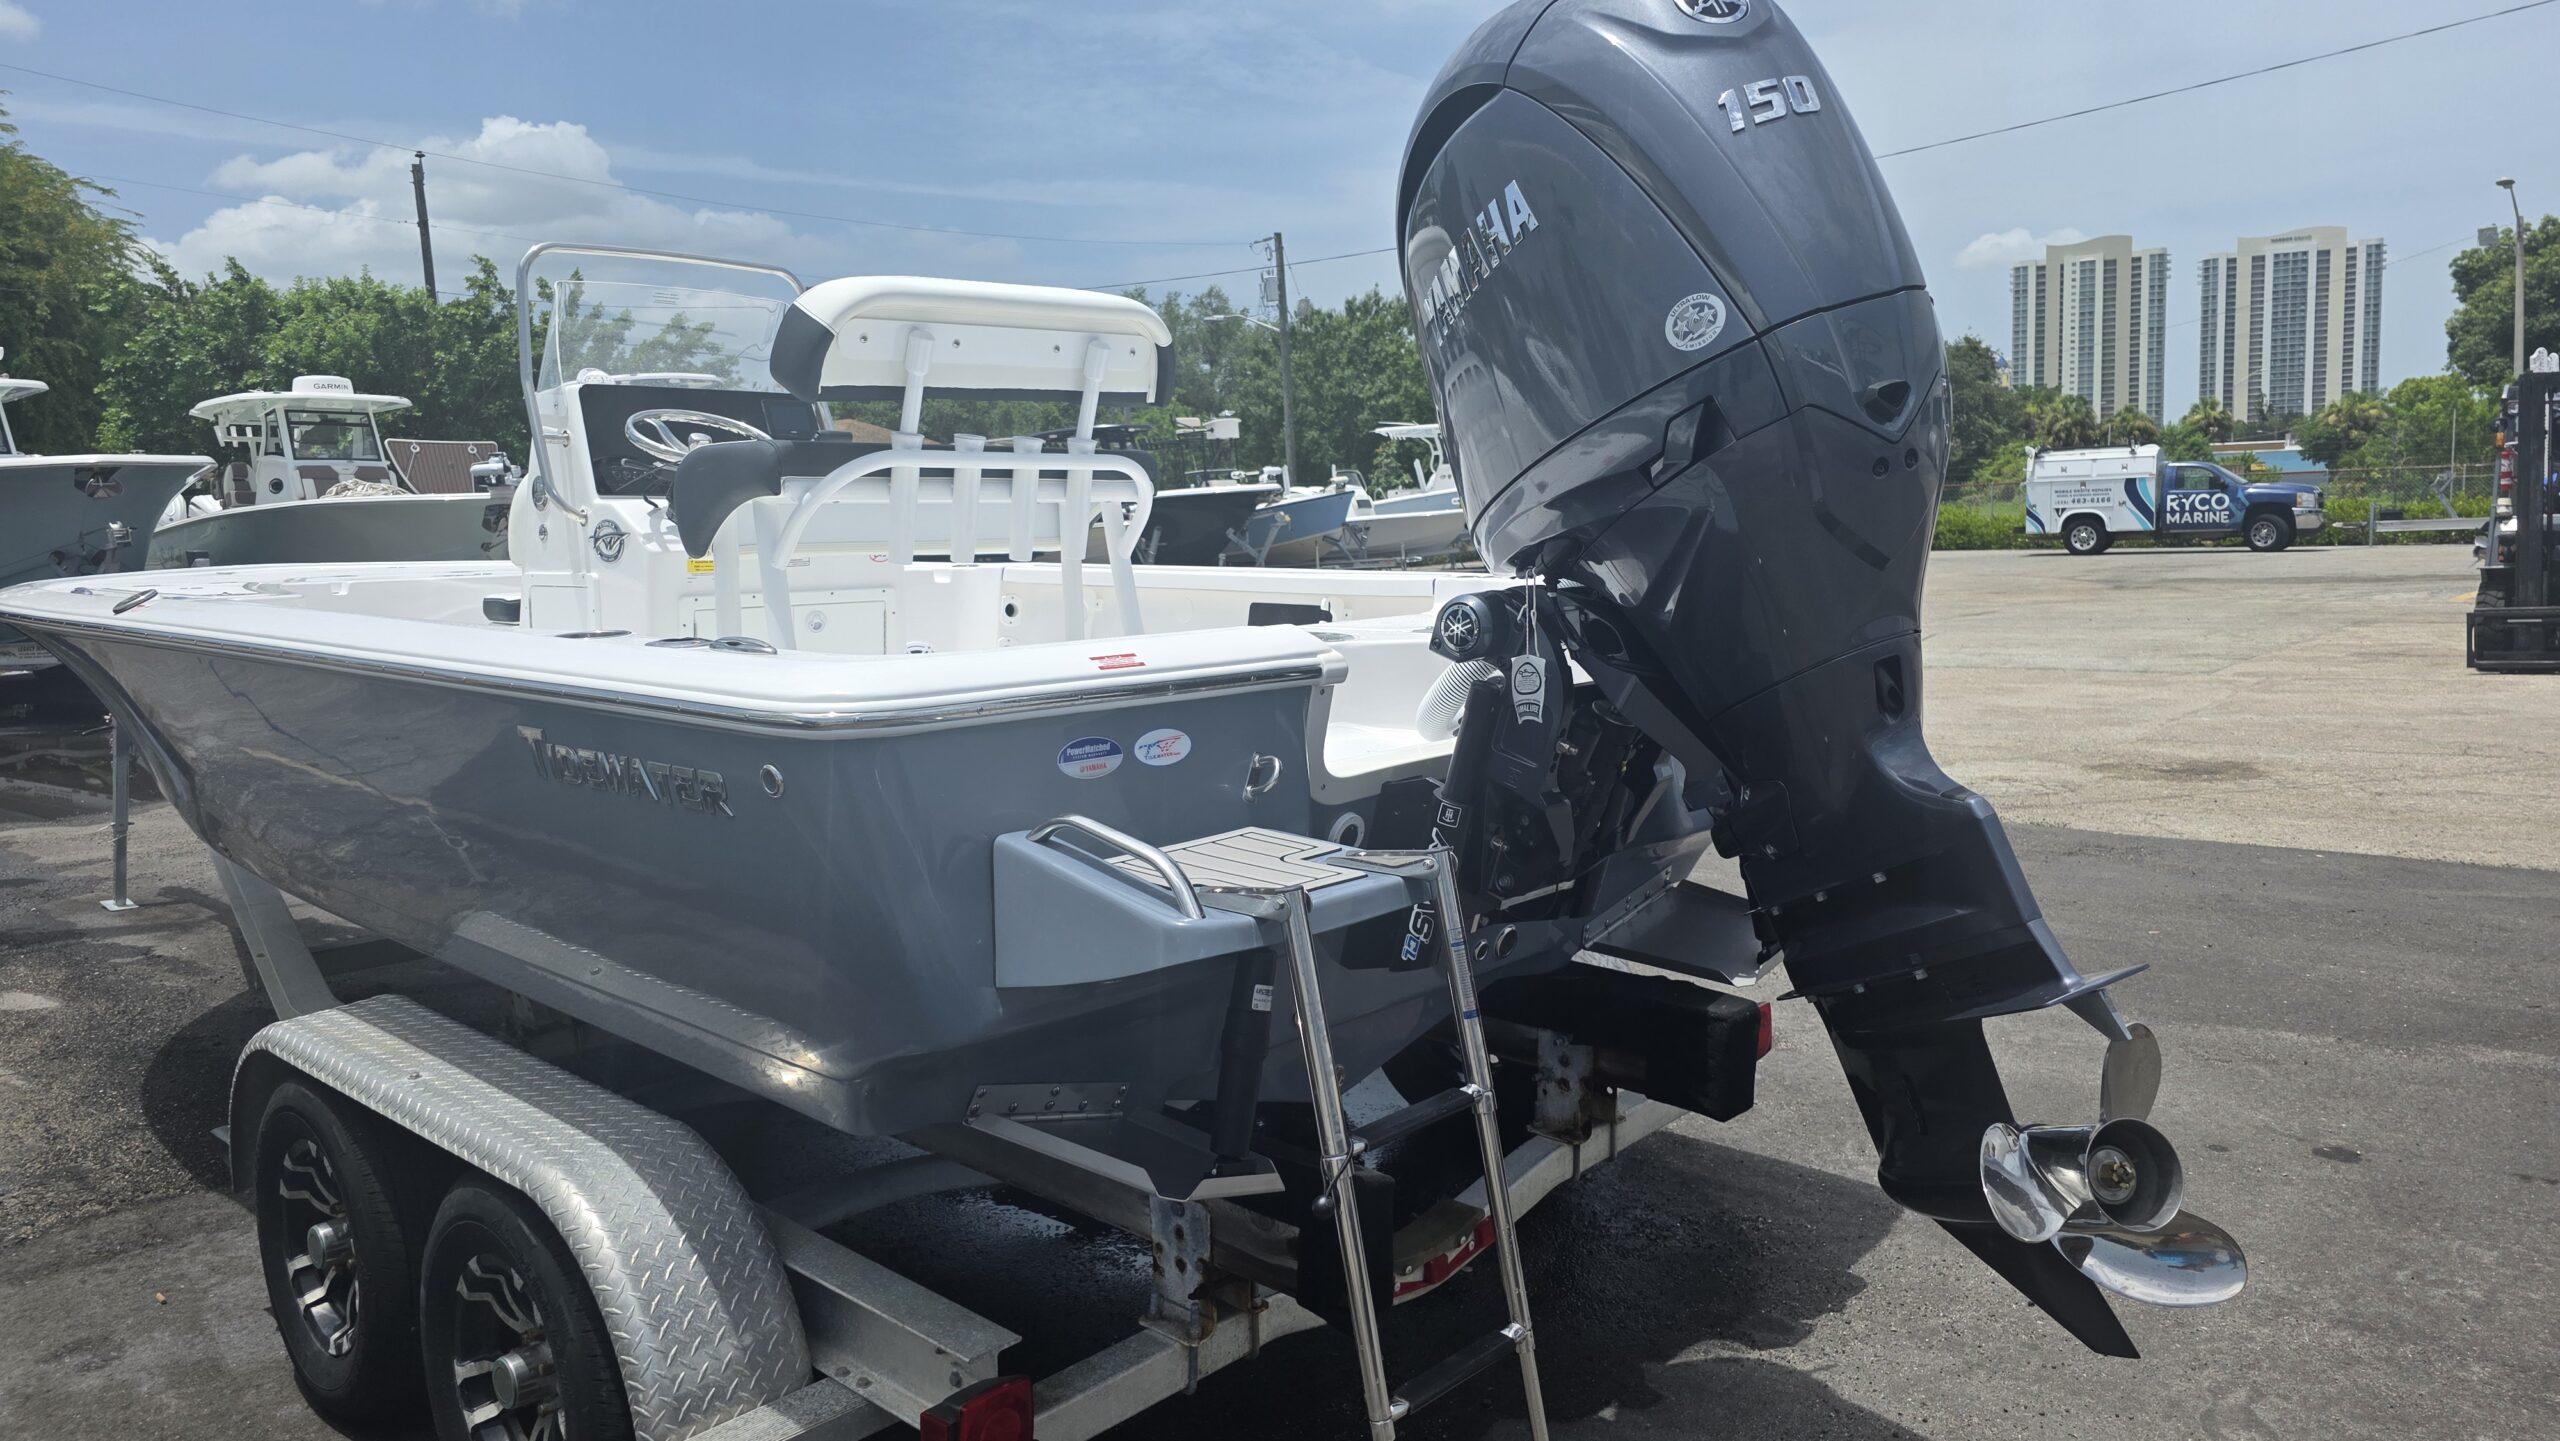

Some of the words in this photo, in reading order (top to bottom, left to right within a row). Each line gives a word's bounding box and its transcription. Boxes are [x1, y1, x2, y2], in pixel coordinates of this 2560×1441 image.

[1718, 75, 1821, 133] 150
[1423, 179, 1539, 347] YAMAHA
[1685, 330, 1718, 348] EMISSION
[2166, 492, 2230, 512] RYCO
[2166, 511, 2230, 524] MARINE
[1066, 742, 1112, 757] PowerMatched
[516, 725, 735, 817] TIDEWATER
[1085, 762, 1108, 772] YAMAHA
